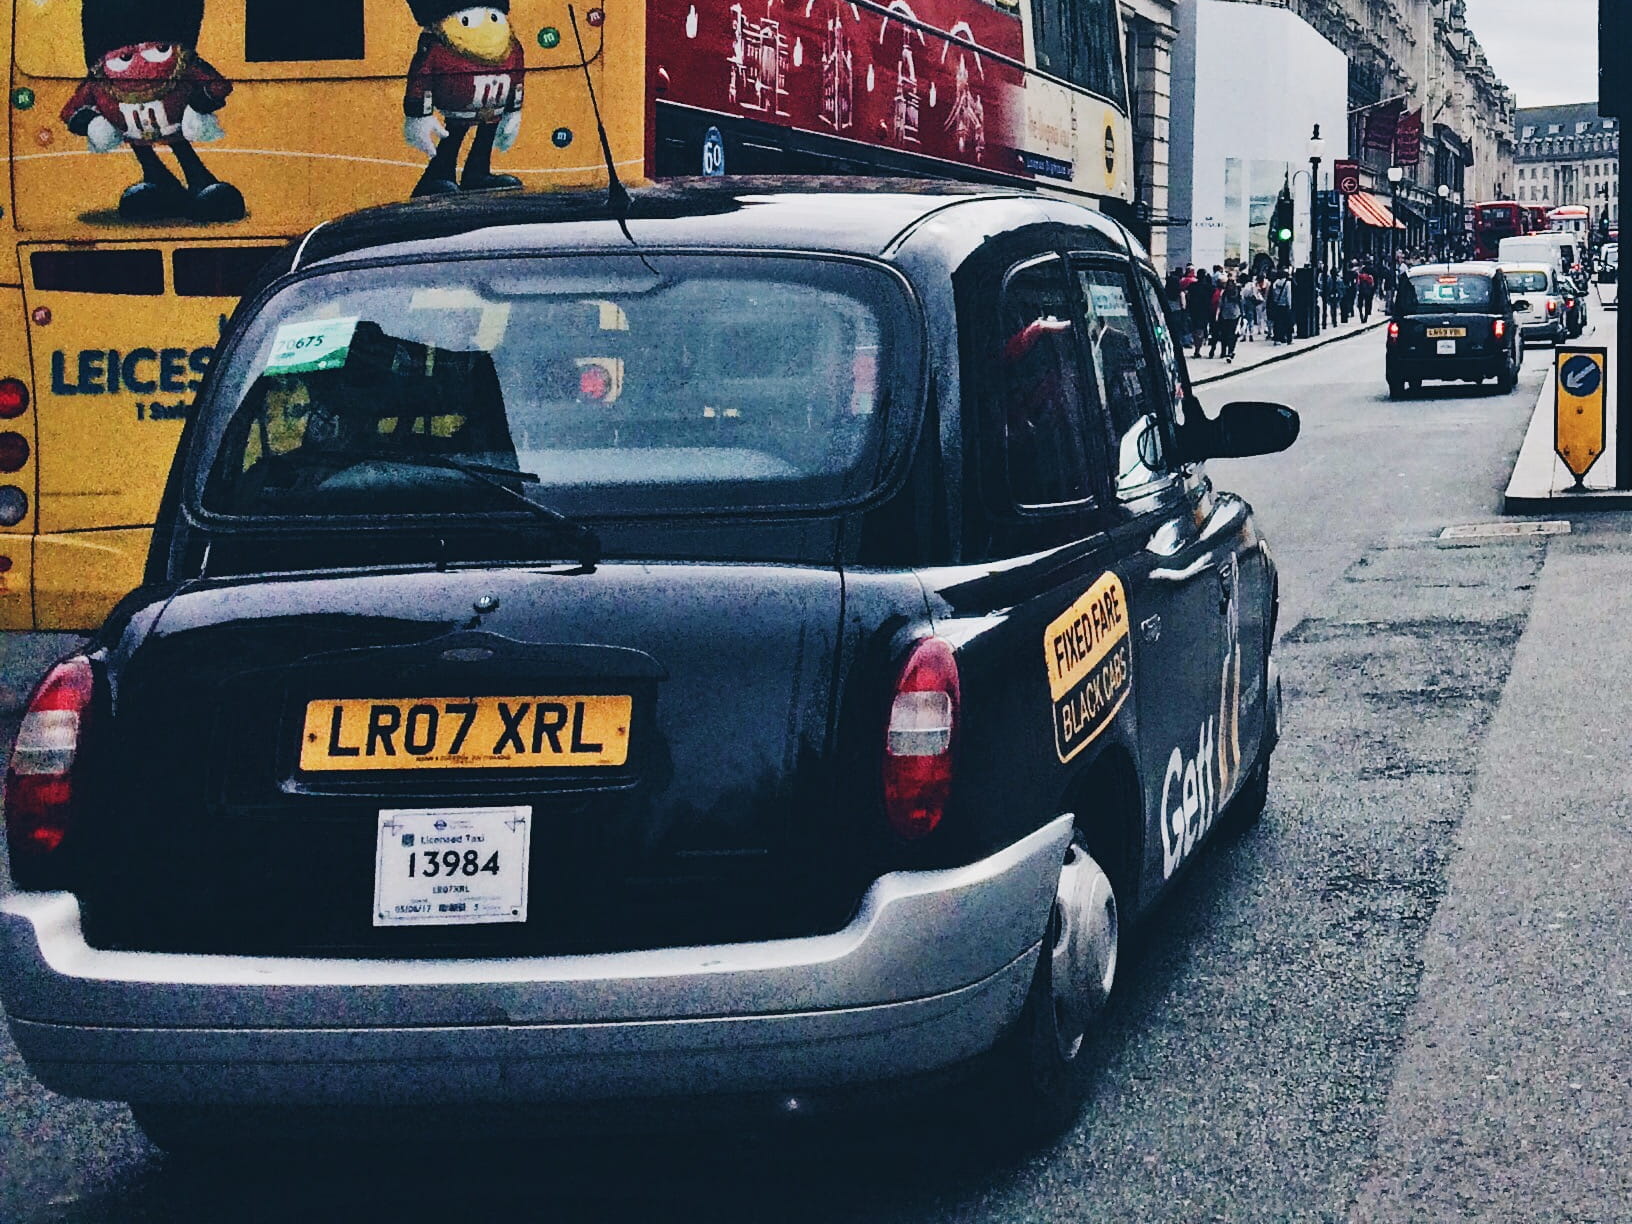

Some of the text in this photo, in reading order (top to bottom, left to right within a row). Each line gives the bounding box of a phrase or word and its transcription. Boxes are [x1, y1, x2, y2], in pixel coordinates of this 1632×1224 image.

[1053, 584, 1122, 679] FIXED FARE
[1061, 645, 1128, 743] BLACK CABS
[327, 701, 604, 757] LR07 XRL
[408, 849, 500, 878] 13984
[420, 833, 485, 845] Licensed Taxi
